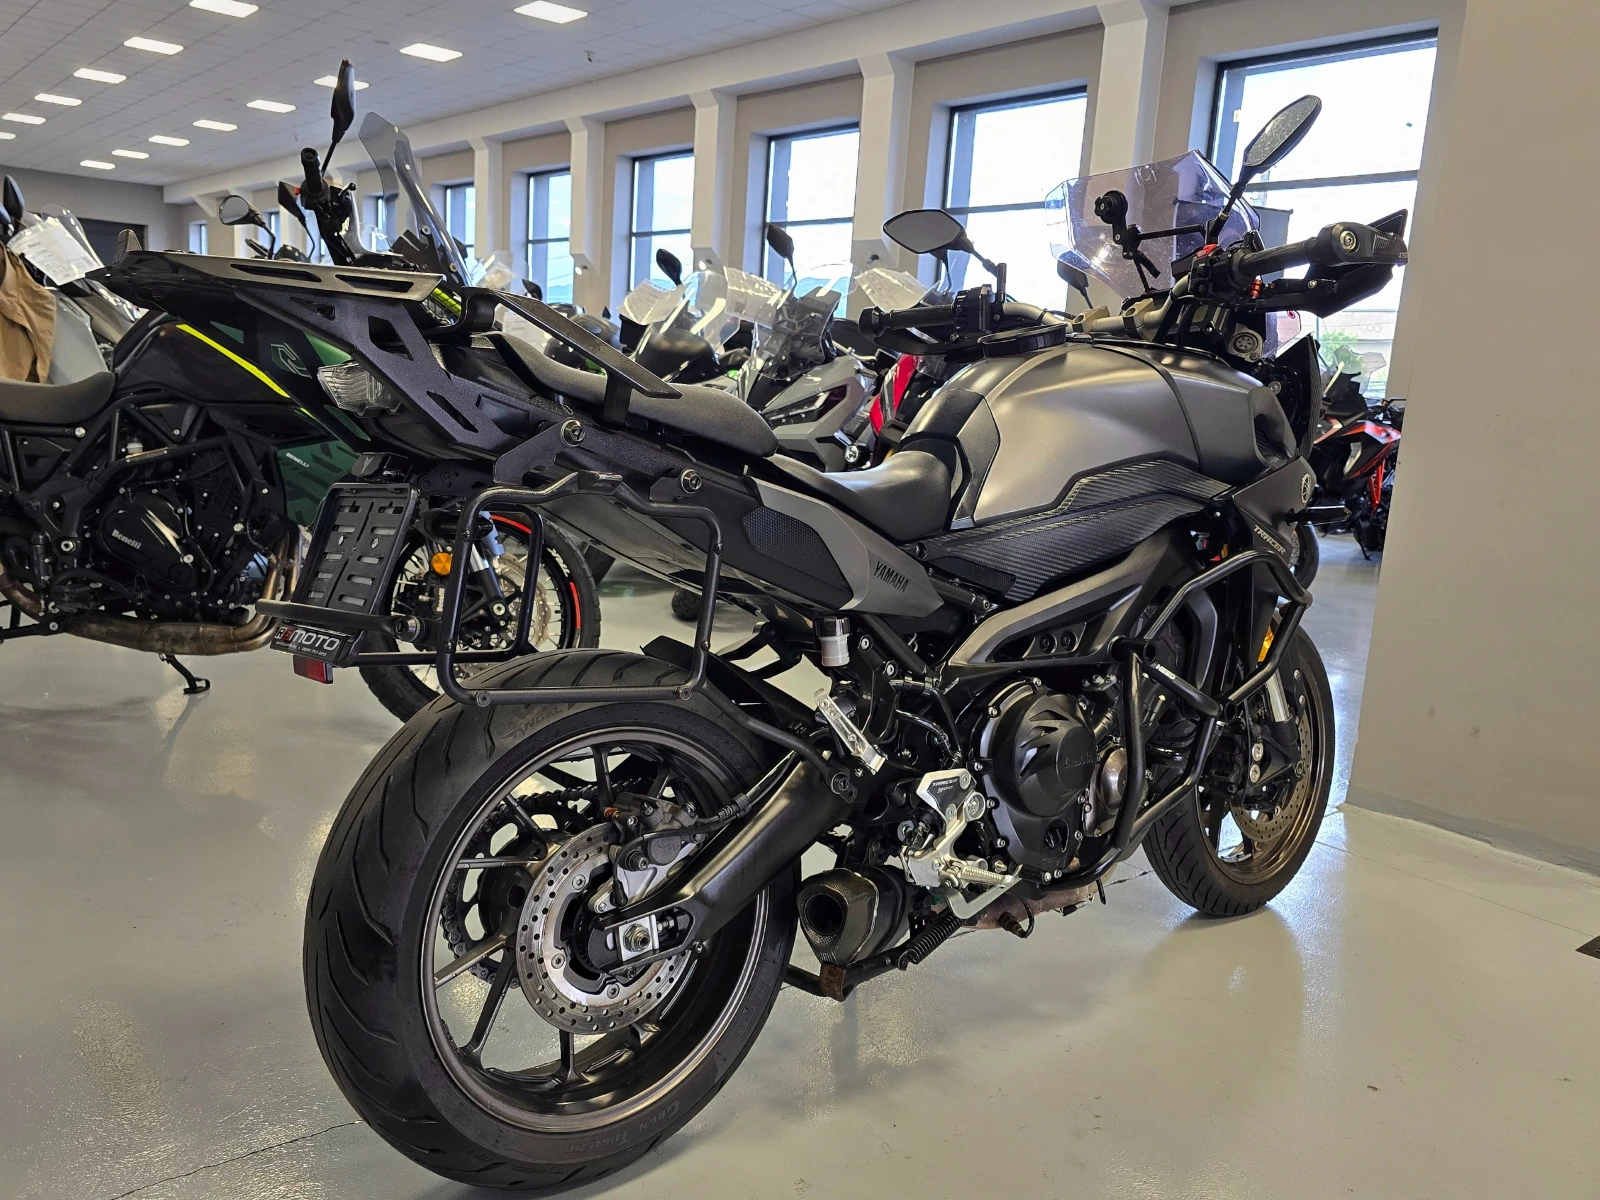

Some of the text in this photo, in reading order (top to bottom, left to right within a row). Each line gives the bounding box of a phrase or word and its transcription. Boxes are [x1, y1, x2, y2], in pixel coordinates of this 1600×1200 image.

[111, 529, 142, 550] Benelli
[1253, 524, 1287, 555] TRACER
[873, 560, 909, 594] YAMAHA
[564, 1100, 680, 1154] GRAN TURISMO
